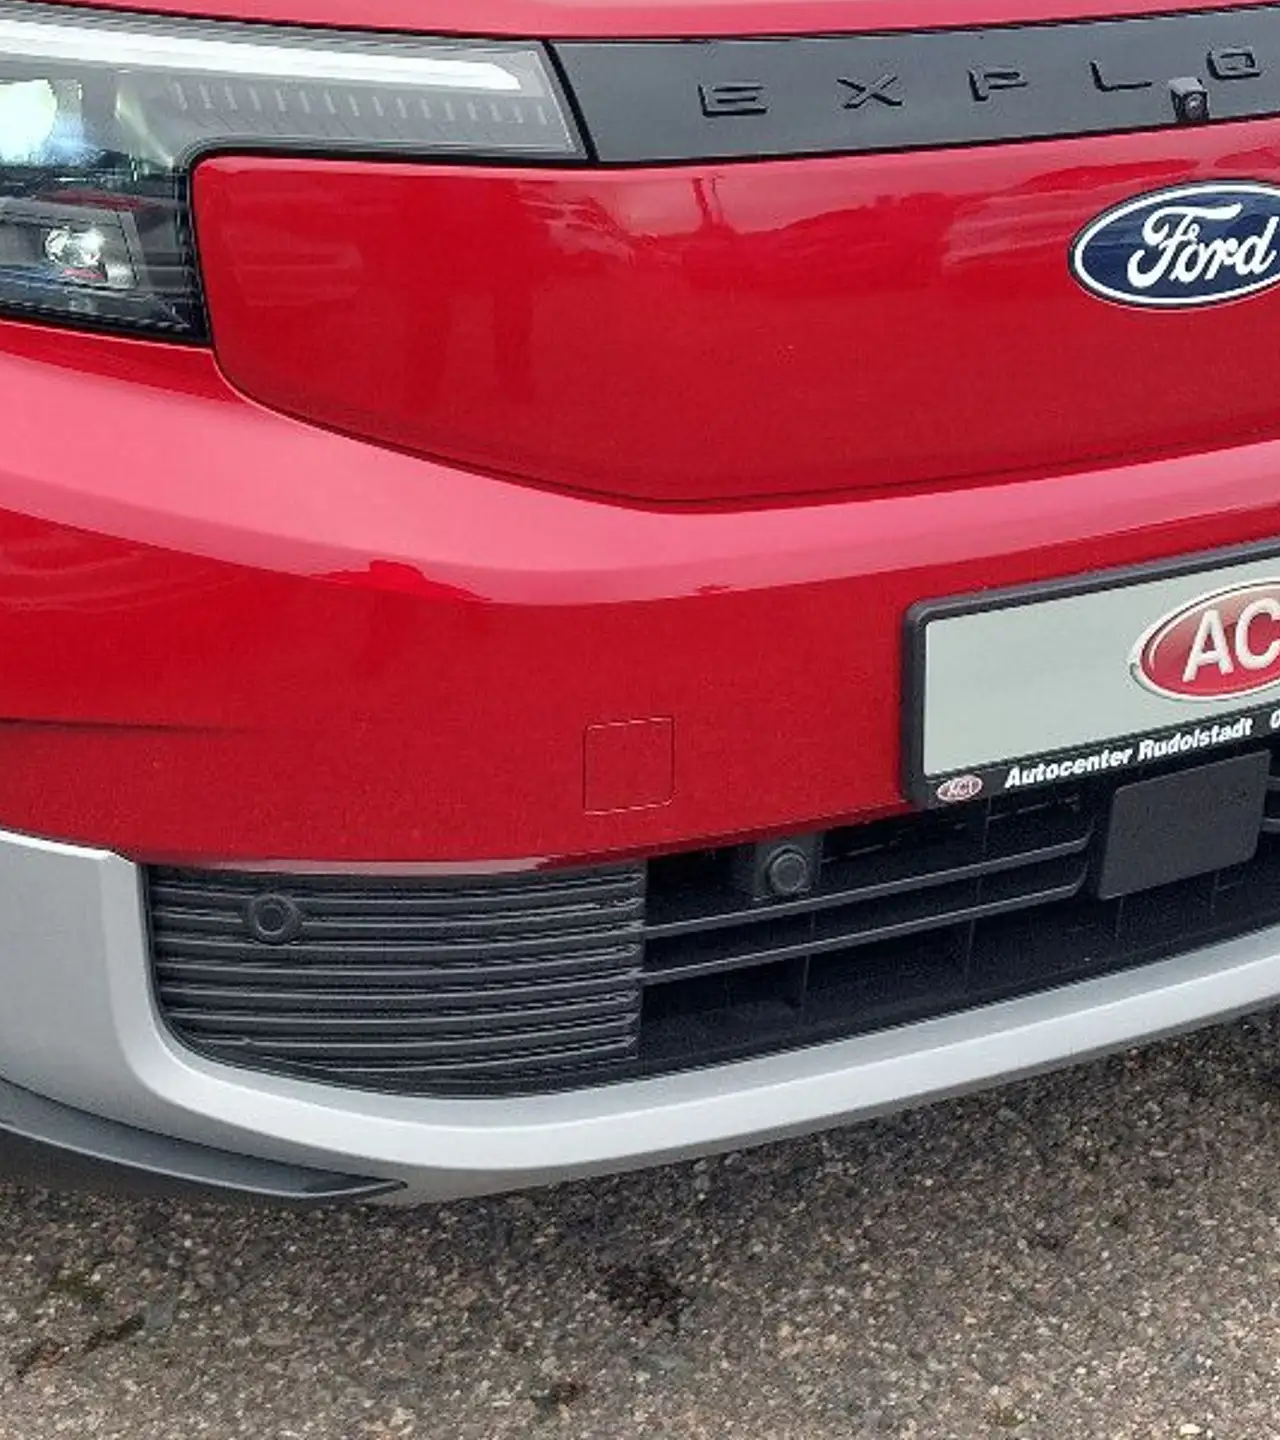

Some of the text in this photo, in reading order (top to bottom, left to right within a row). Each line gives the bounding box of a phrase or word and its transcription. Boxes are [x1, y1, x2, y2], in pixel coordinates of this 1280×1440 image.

[1126, 202, 1277, 288] Ford
[1004, 747, 1133, 789] Autocenter
[1137, 717, 1254, 762] Rudolstadt
